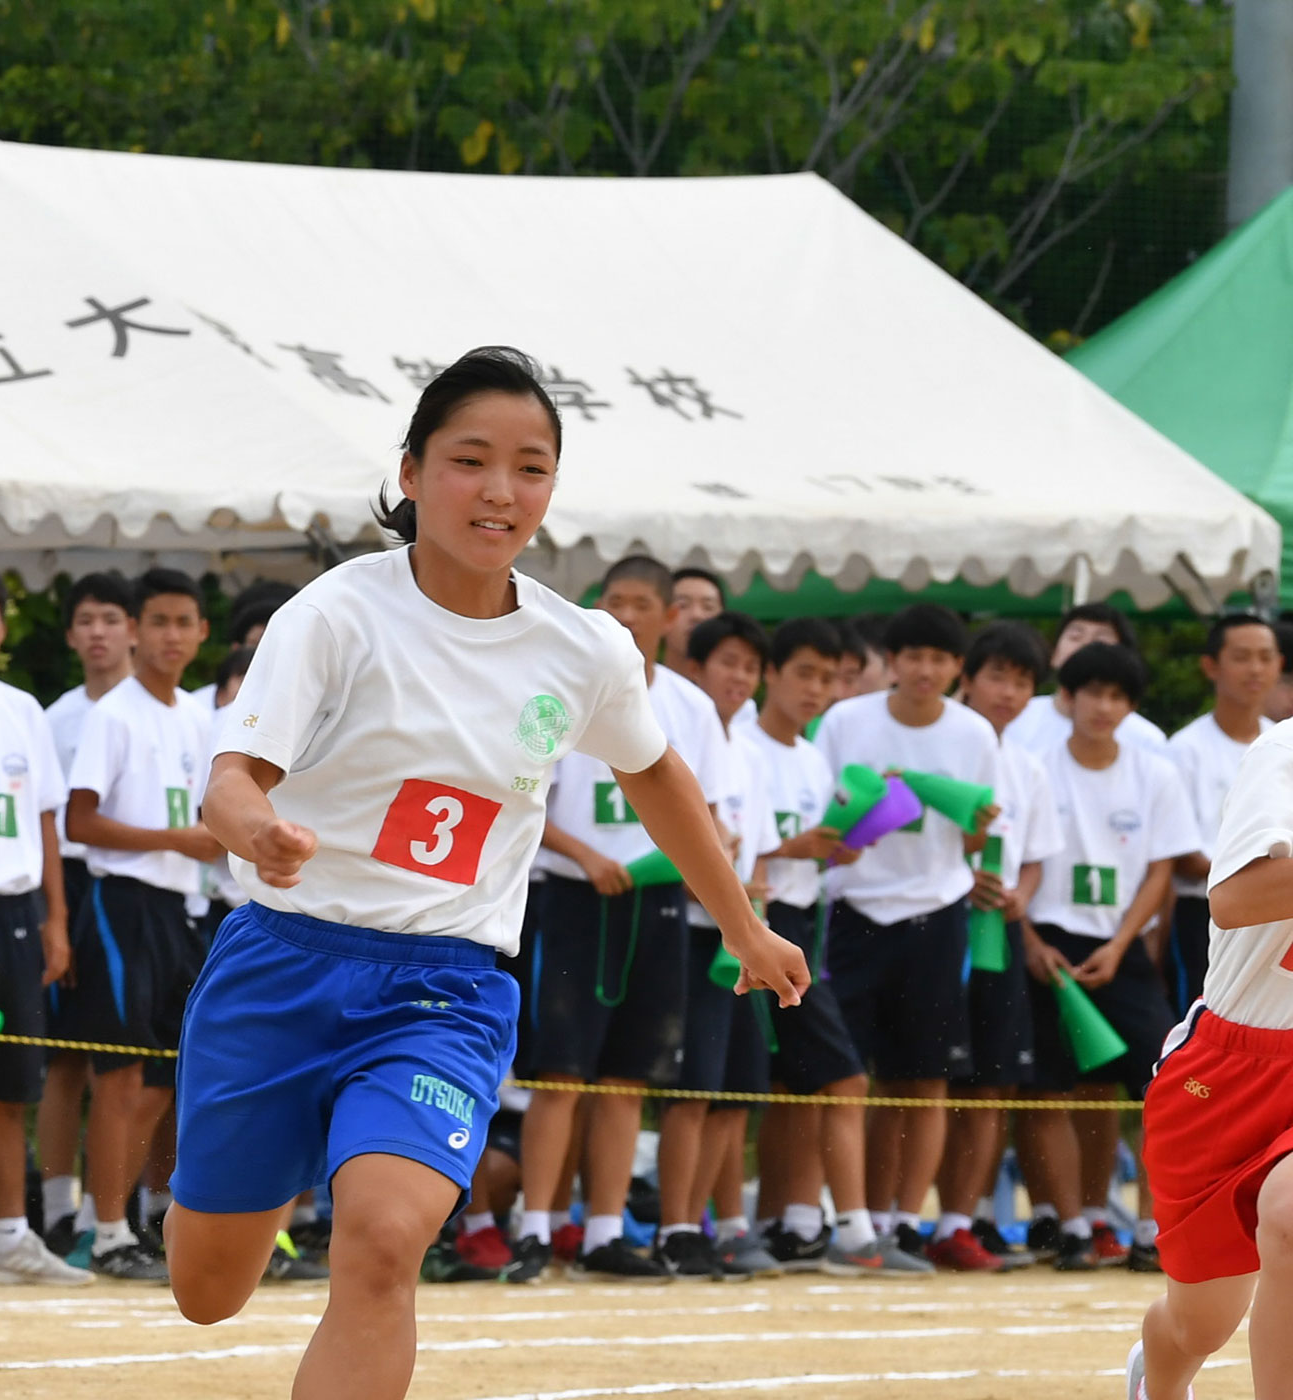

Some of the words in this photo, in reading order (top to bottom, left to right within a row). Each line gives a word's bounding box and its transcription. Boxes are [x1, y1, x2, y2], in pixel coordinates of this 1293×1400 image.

[606, 784, 625, 821] 1
[409, 795, 465, 867] 3
[1086, 866, 1102, 902] 1
[411, 1074, 476, 1128] OTSUKA
[1184, 1077, 1210, 1098] asics
